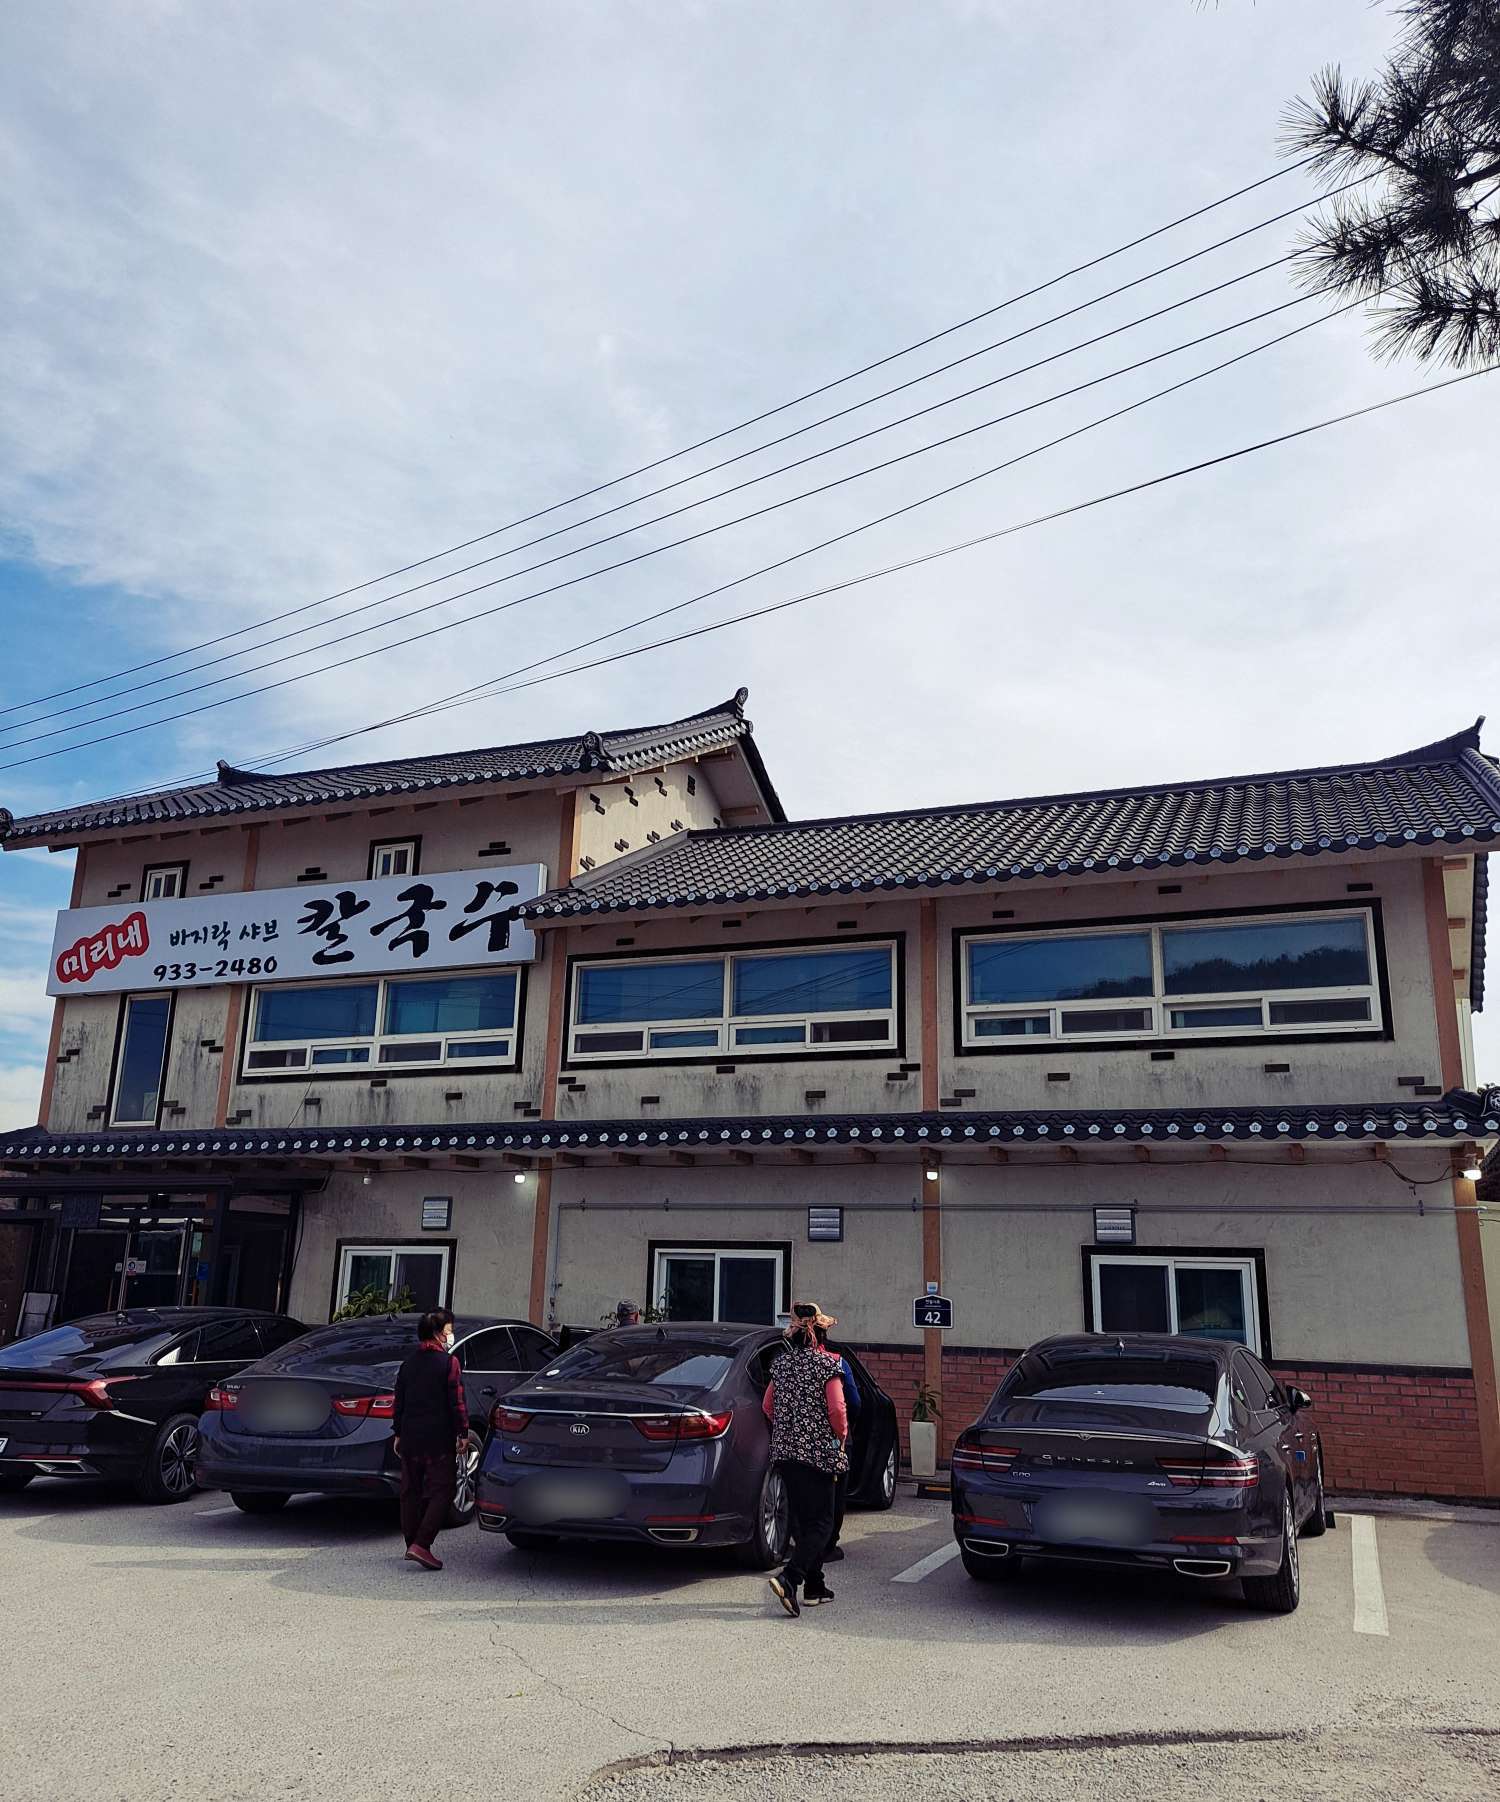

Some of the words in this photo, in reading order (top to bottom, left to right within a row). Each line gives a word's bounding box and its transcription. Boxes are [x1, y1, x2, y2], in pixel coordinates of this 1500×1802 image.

[169, 921, 231, 950] 바지락
[239, 919, 279, 942] 샤브
[297, 881, 520, 965] 칼국수
[62, 919, 143, 974] 미리내
[153, 956, 278, 981] 933-2480
[924, 1311, 941, 1324] 42
[572, 1426, 587, 1434] KIA
